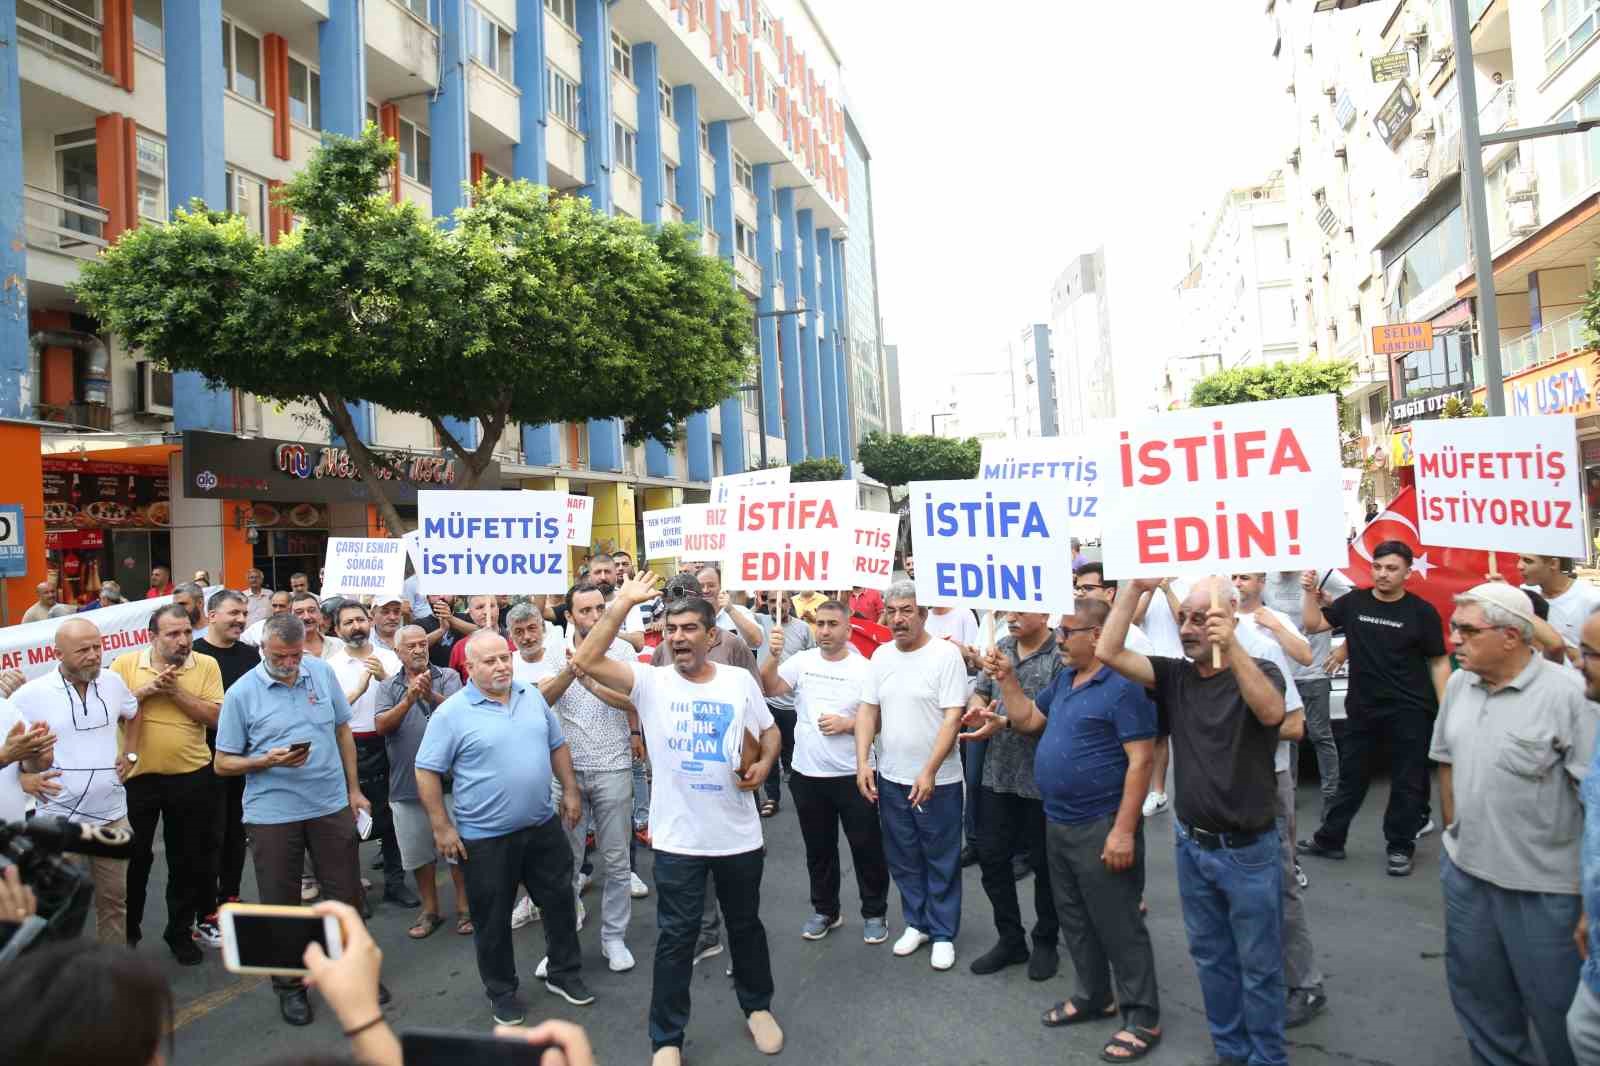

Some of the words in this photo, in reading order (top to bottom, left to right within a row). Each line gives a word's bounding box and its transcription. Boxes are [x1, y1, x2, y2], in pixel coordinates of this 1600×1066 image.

[1535, 367, 1585, 413] USTA
[1119, 421, 1312, 488] İSTİFA
[1419, 443, 1567, 488] MÜFETTİŞ
[424, 511, 560, 544] MÜFETTİŞ
[738, 493, 839, 532] İSTİFA
[927, 492, 1050, 539] İSTİFA
[1420, 490, 1574, 530] İSTİYORUZ
[335, 541, 363, 556] ÇARŞI
[1136, 501, 1302, 564] EDİN!
[346, 555, 385, 571] SOKAĞA
[423, 547, 563, 576] İSTİYORUZ
[741, 543, 830, 582] EDİN!
[936, 554, 1043, 602] EDİN!
[341, 575, 386, 589] ATILMAZ!
